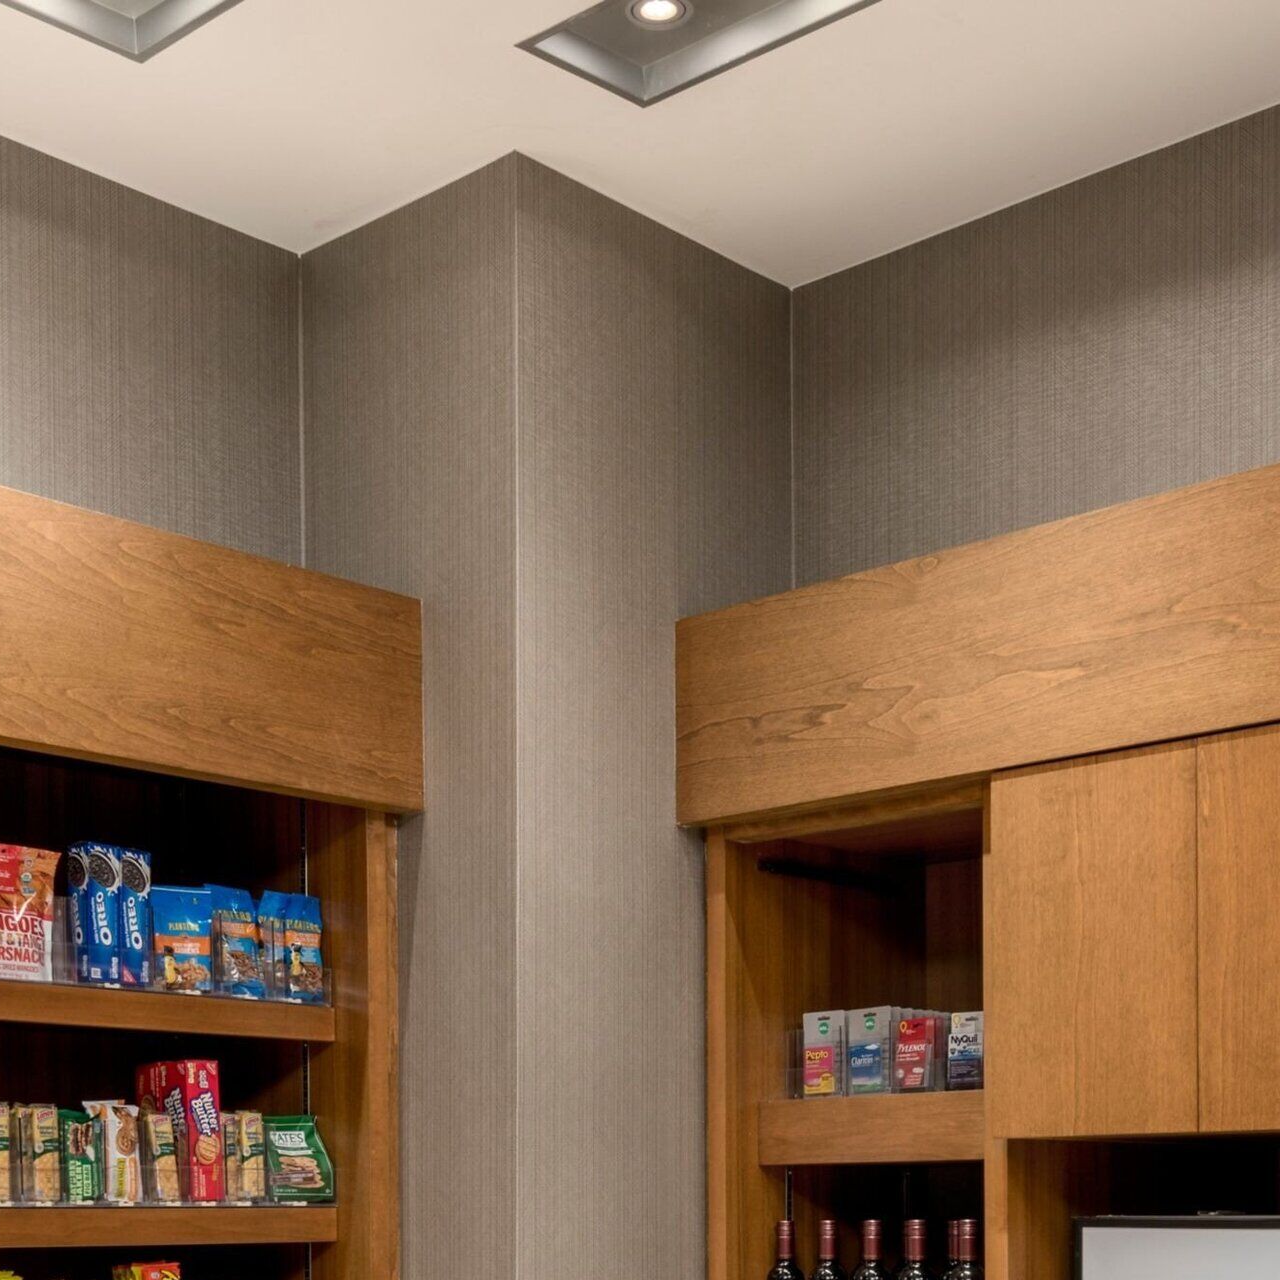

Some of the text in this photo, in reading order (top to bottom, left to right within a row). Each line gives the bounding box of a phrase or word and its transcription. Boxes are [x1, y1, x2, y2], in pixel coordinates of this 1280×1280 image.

[95, 891, 113, 946] OREO
[127, 896, 144, 951] OREO
[6, 932, 15, 946] &
[897, 1043, 927, 1053] TYLENOL
[950, 1034, 979, 1046] NyQuil
[805, 1050, 828, 1061] Pepto
[190, 1097, 212, 1138] Butter
[201, 1091, 220, 1132] Nutter
